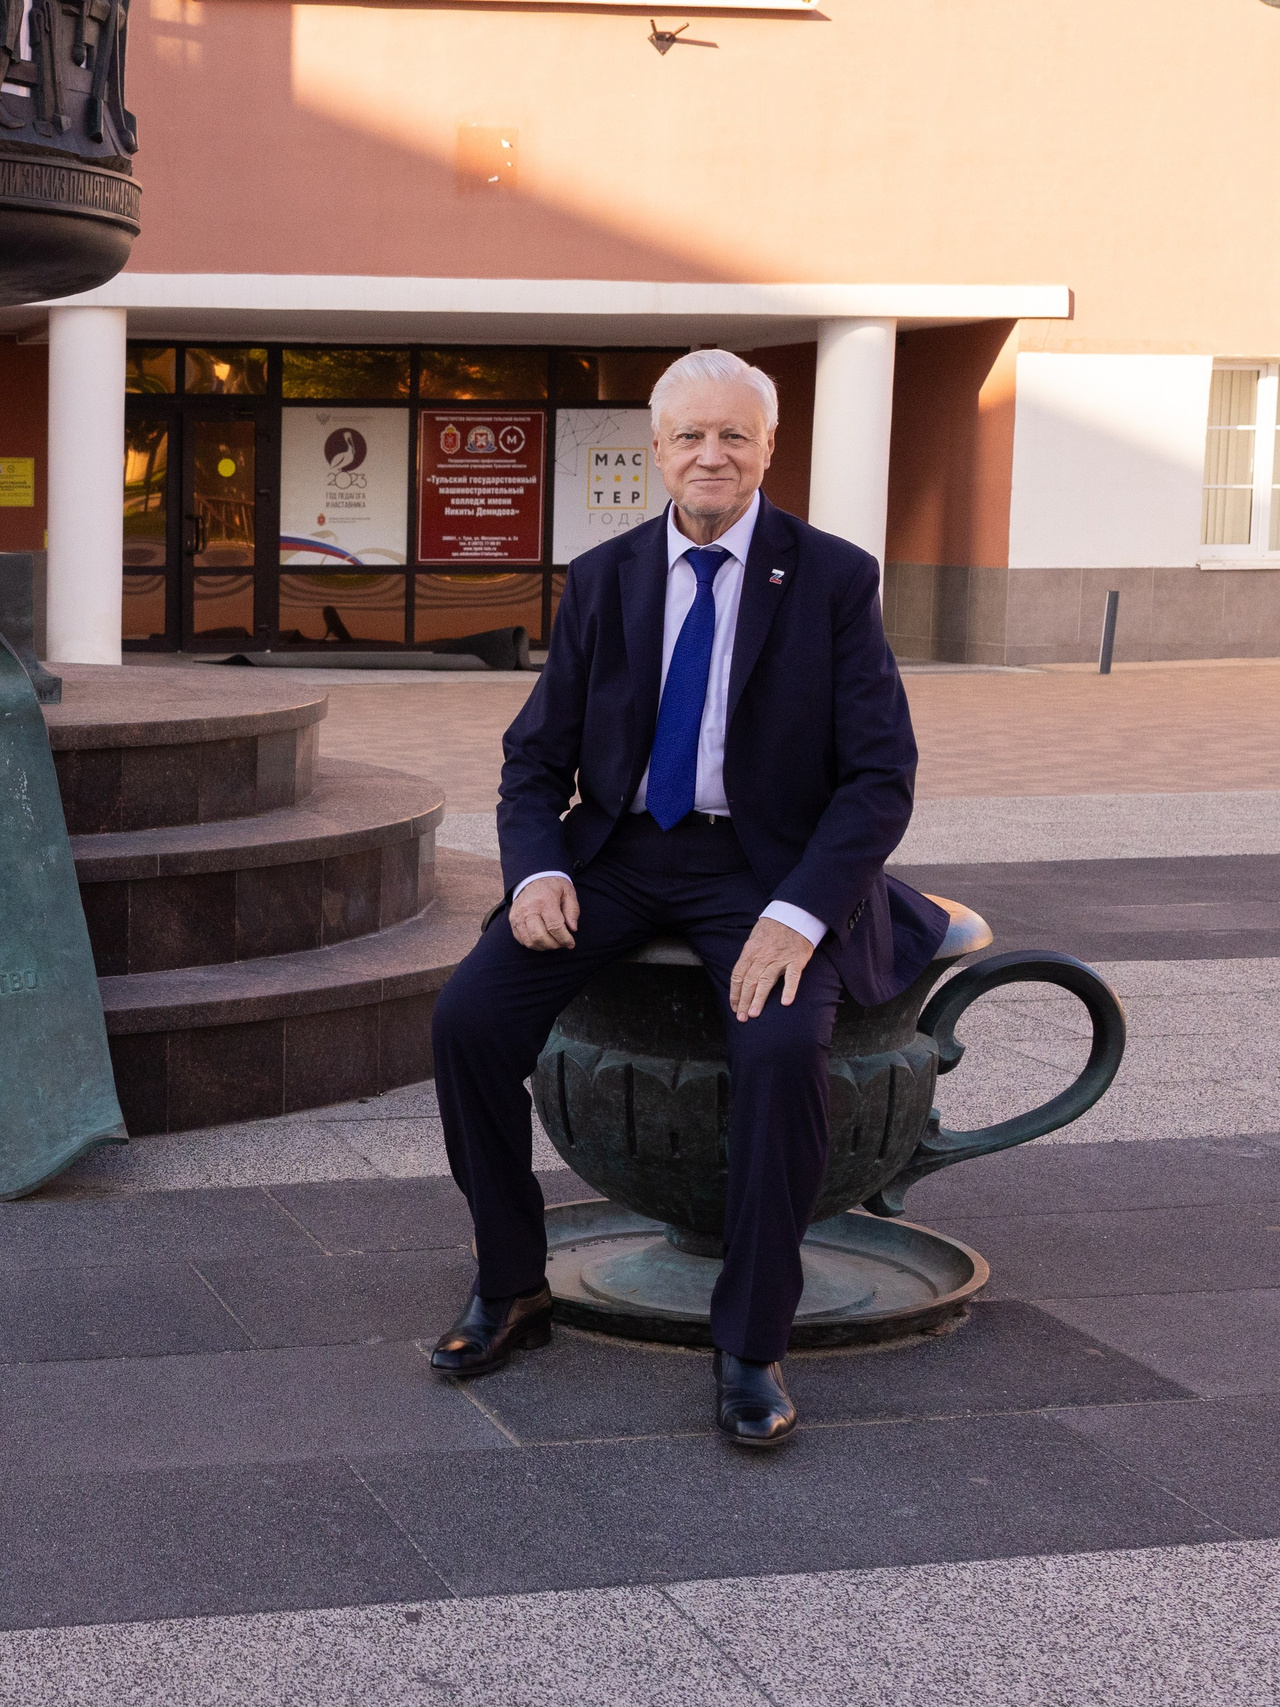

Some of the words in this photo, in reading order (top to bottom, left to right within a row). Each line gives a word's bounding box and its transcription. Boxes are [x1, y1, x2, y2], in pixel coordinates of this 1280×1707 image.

[22, 163, 68, 202] ЭСКИЗ
[595, 453, 642, 466] МАС
[327, 471, 368, 490] 2023
[427, 475, 467, 485] «Тульский
[469, 475, 537, 486] государственный
[439, 486, 524, 496] машиностроительный
[451, 498, 485, 507] колледж
[594, 491, 640, 503] ТЕР
[444, 507, 474, 516] Никиты
[476, 507, 519, 517] Демидова»
